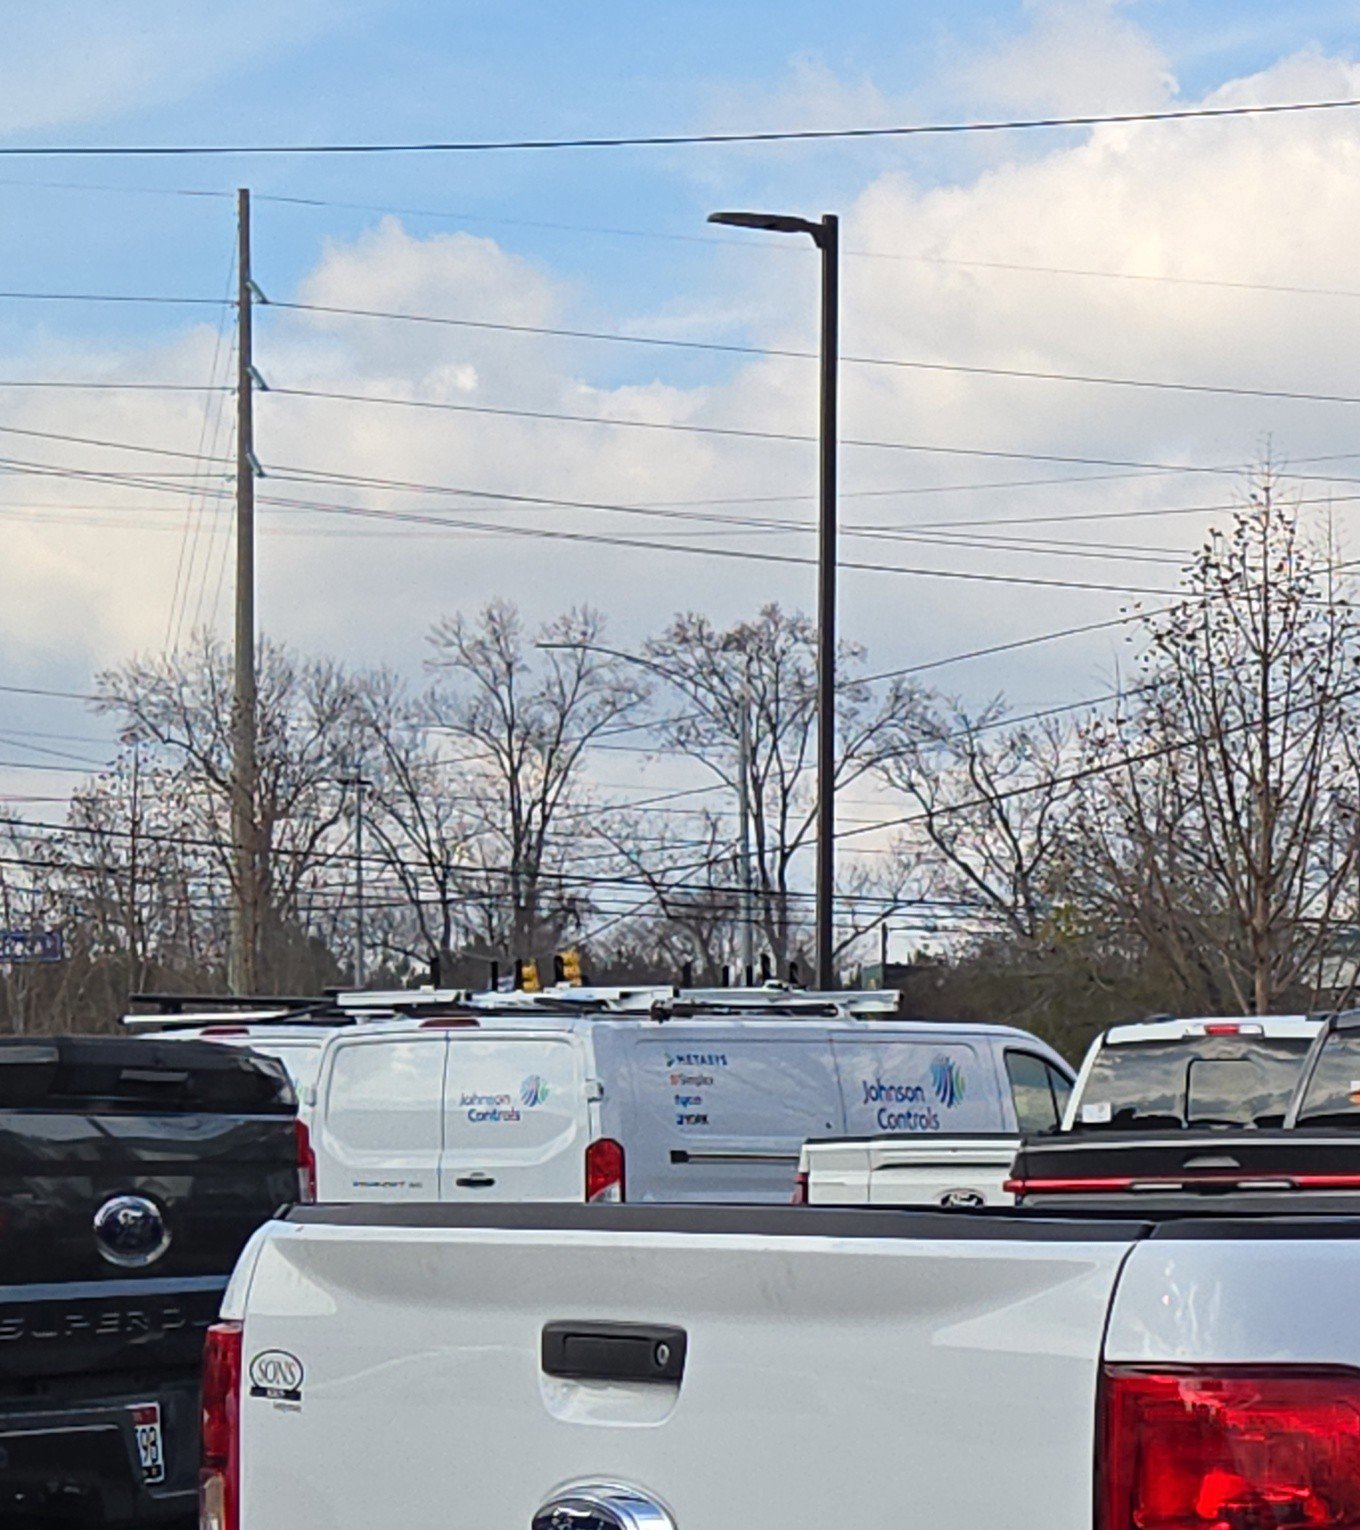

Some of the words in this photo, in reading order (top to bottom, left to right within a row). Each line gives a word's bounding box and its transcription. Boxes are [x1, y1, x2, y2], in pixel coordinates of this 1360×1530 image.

[459, 1092, 511, 1107] Johnson
[862, 1077, 926, 1104] Johnson
[467, 1106, 520, 1122] Controls
[877, 1107, 941, 1131] Controls
[257, 1359, 297, 1386] SONS
